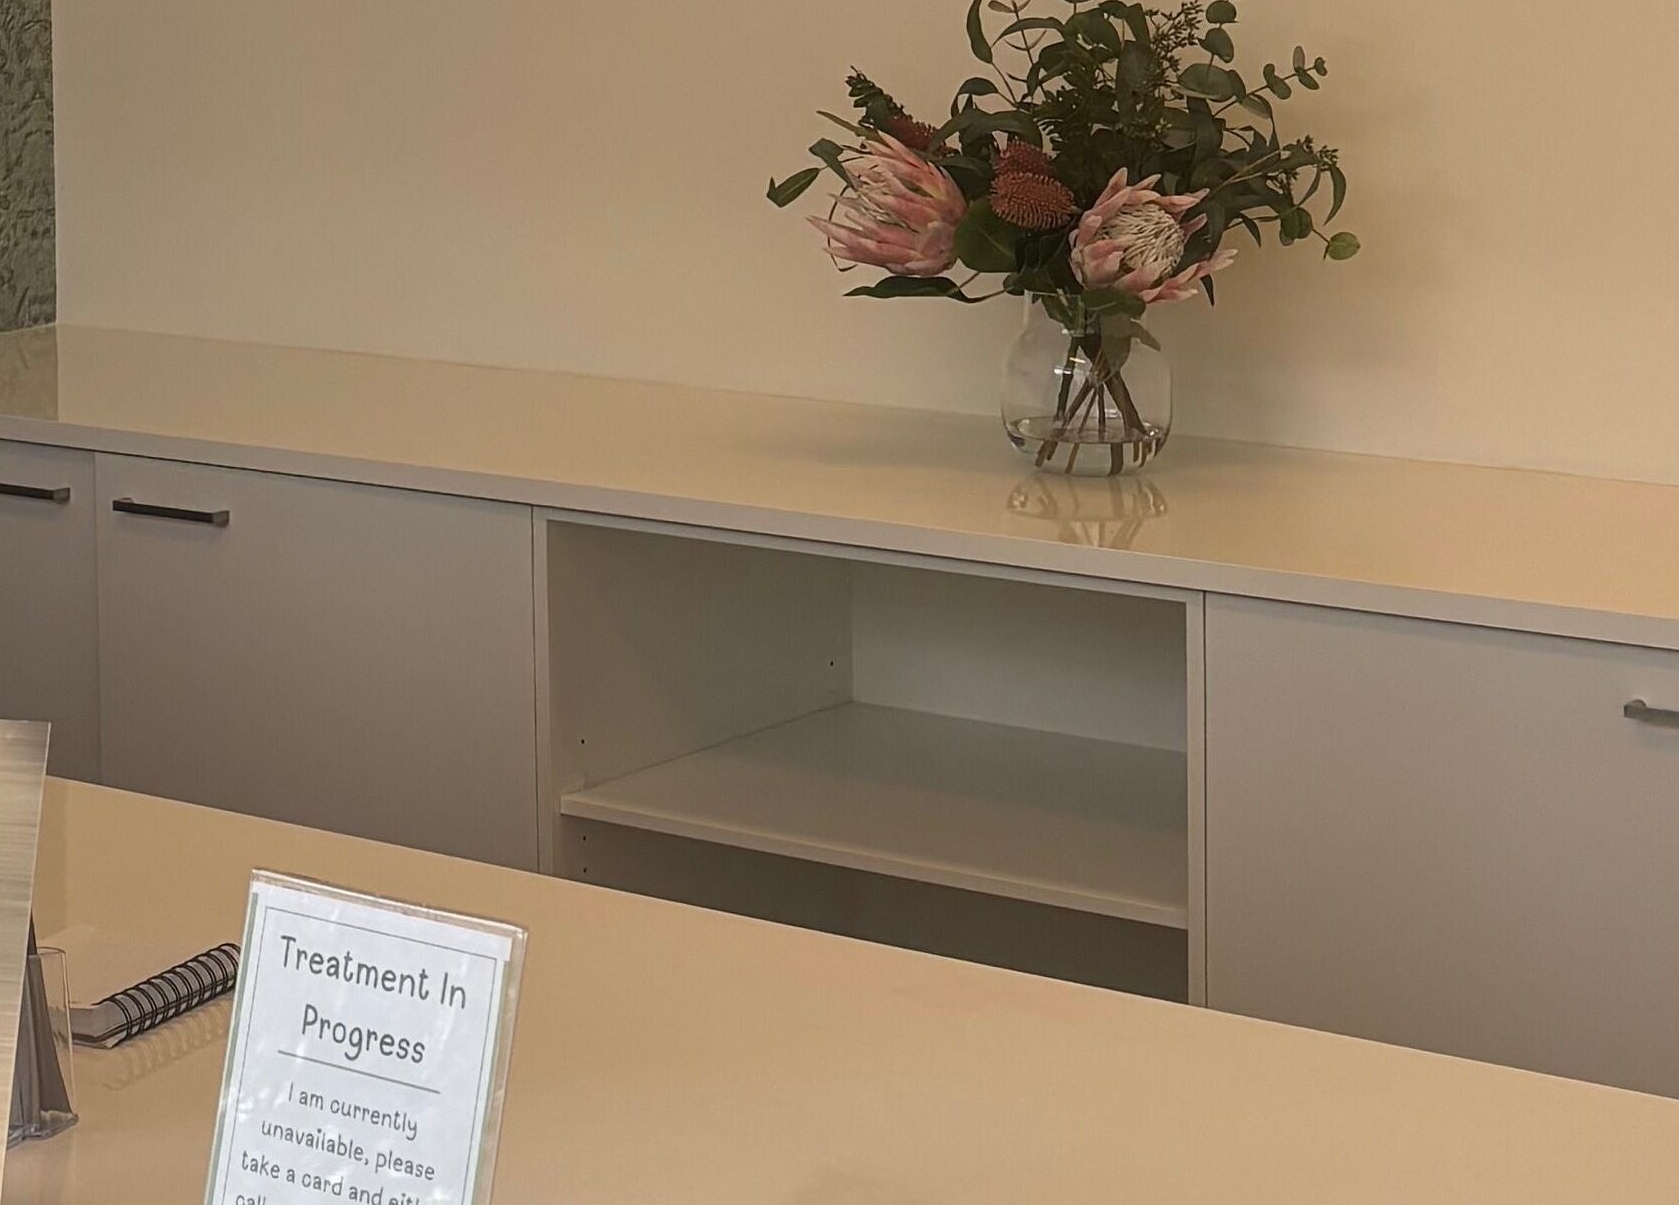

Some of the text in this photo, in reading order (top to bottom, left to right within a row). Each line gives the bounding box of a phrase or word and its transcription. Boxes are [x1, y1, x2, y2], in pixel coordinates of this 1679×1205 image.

[280, 934, 468, 1009] Treatment In
[300, 1003, 426, 1064] Progress
[299, 1087, 324, 1111] am
[330, 1097, 418, 1141] currently
[241, 1149, 281, 1179] take
[286, 1168, 296, 1183] a
[301, 1172, 345, 1196] card
[348, 1186, 384, 1205] and
[260, 1119, 436, 1182] unavailable, please
